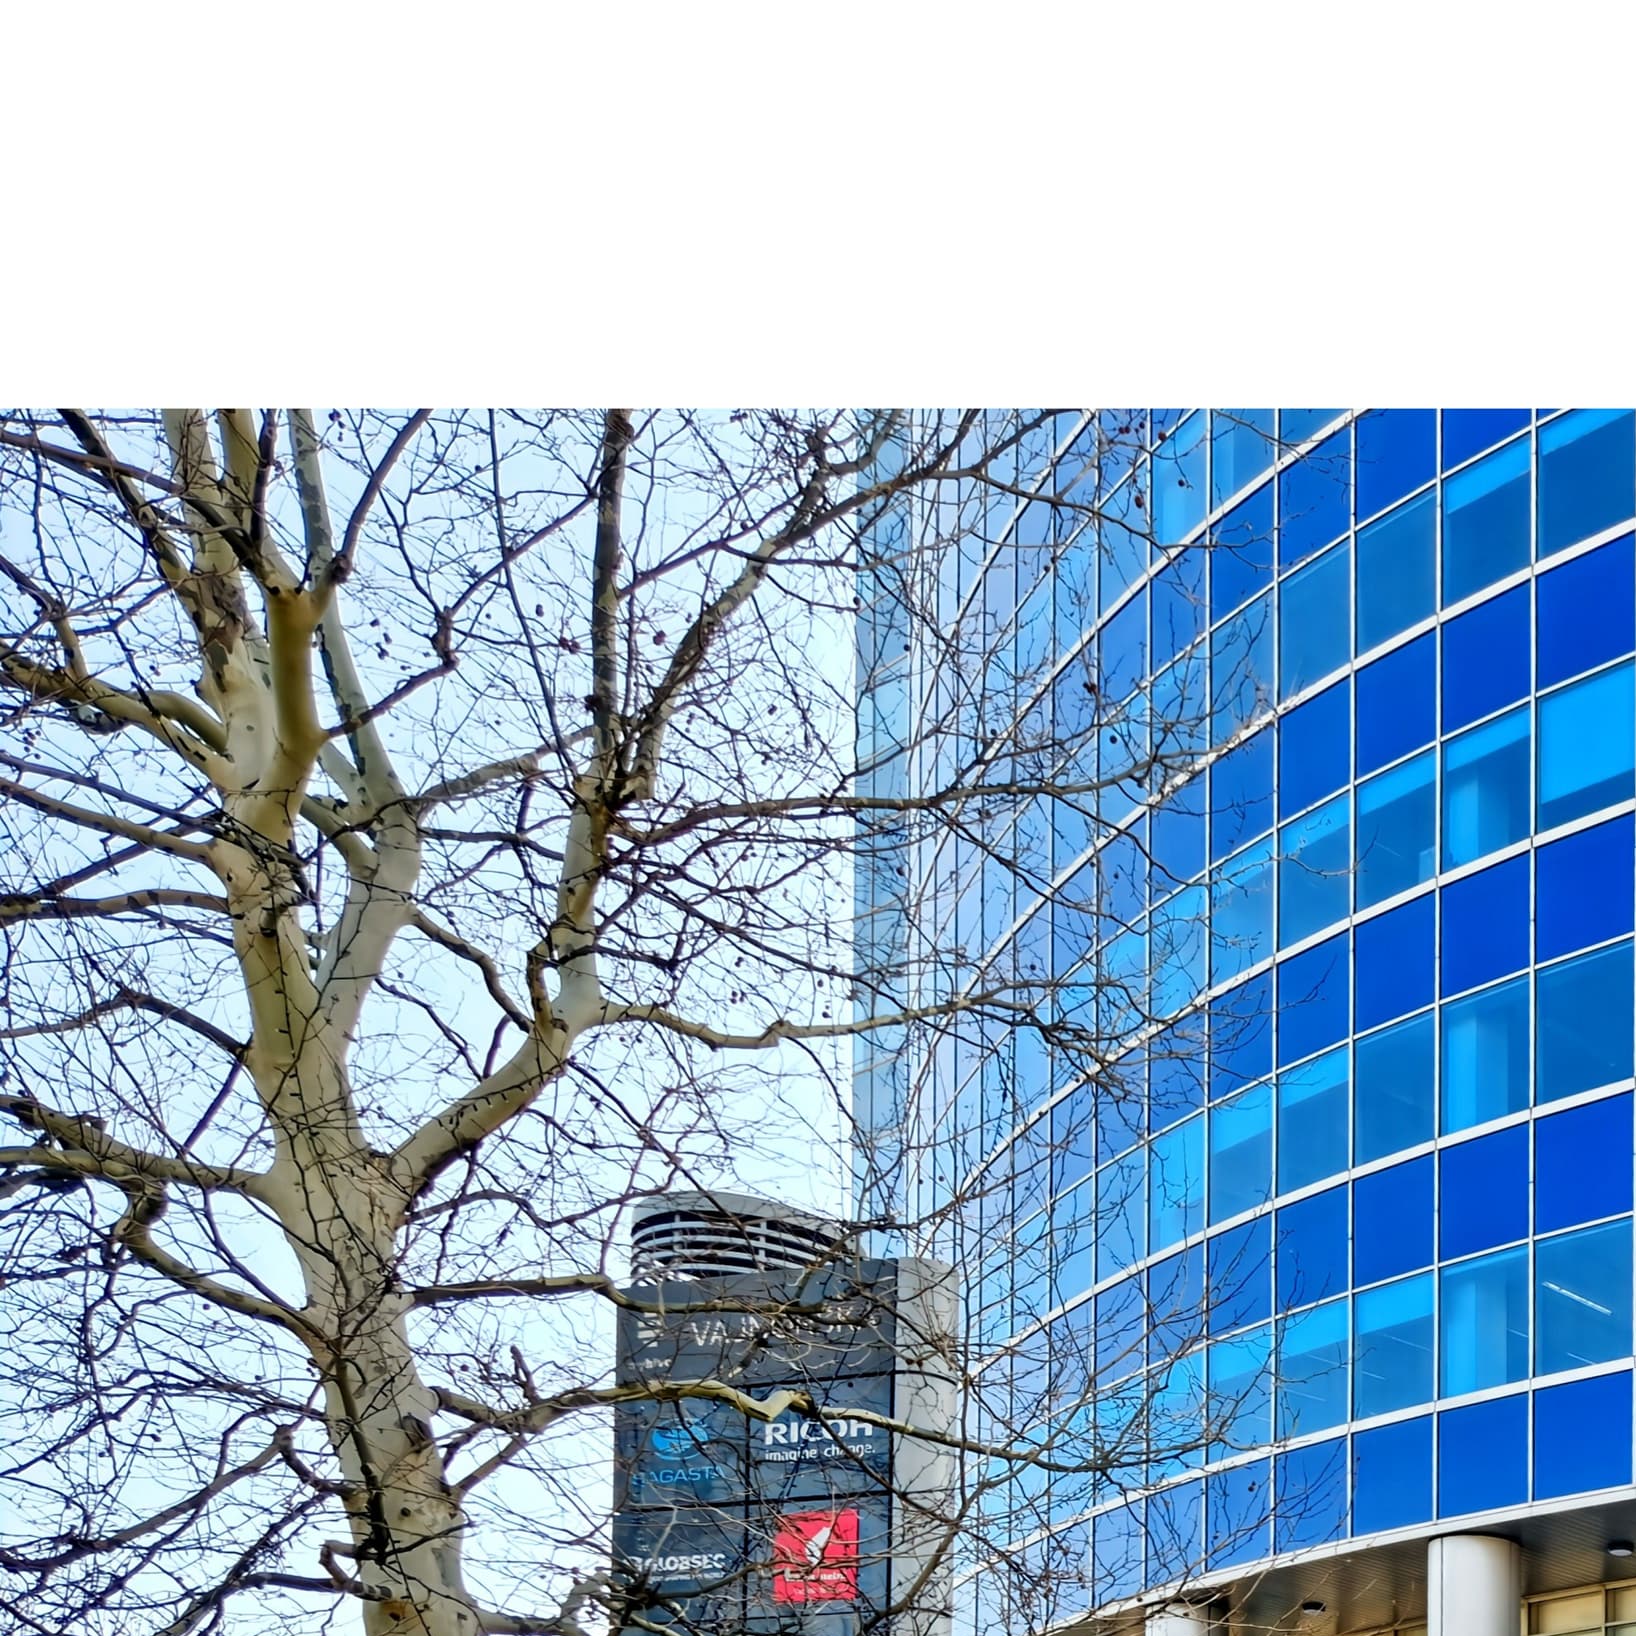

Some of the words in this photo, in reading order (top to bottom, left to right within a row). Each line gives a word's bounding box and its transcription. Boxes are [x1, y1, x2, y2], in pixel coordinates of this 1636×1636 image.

[765, 1419, 873, 1445] RICOH
[765, 1446, 817, 1464] imagine
[824, 1444, 875, 1458] chnge.
